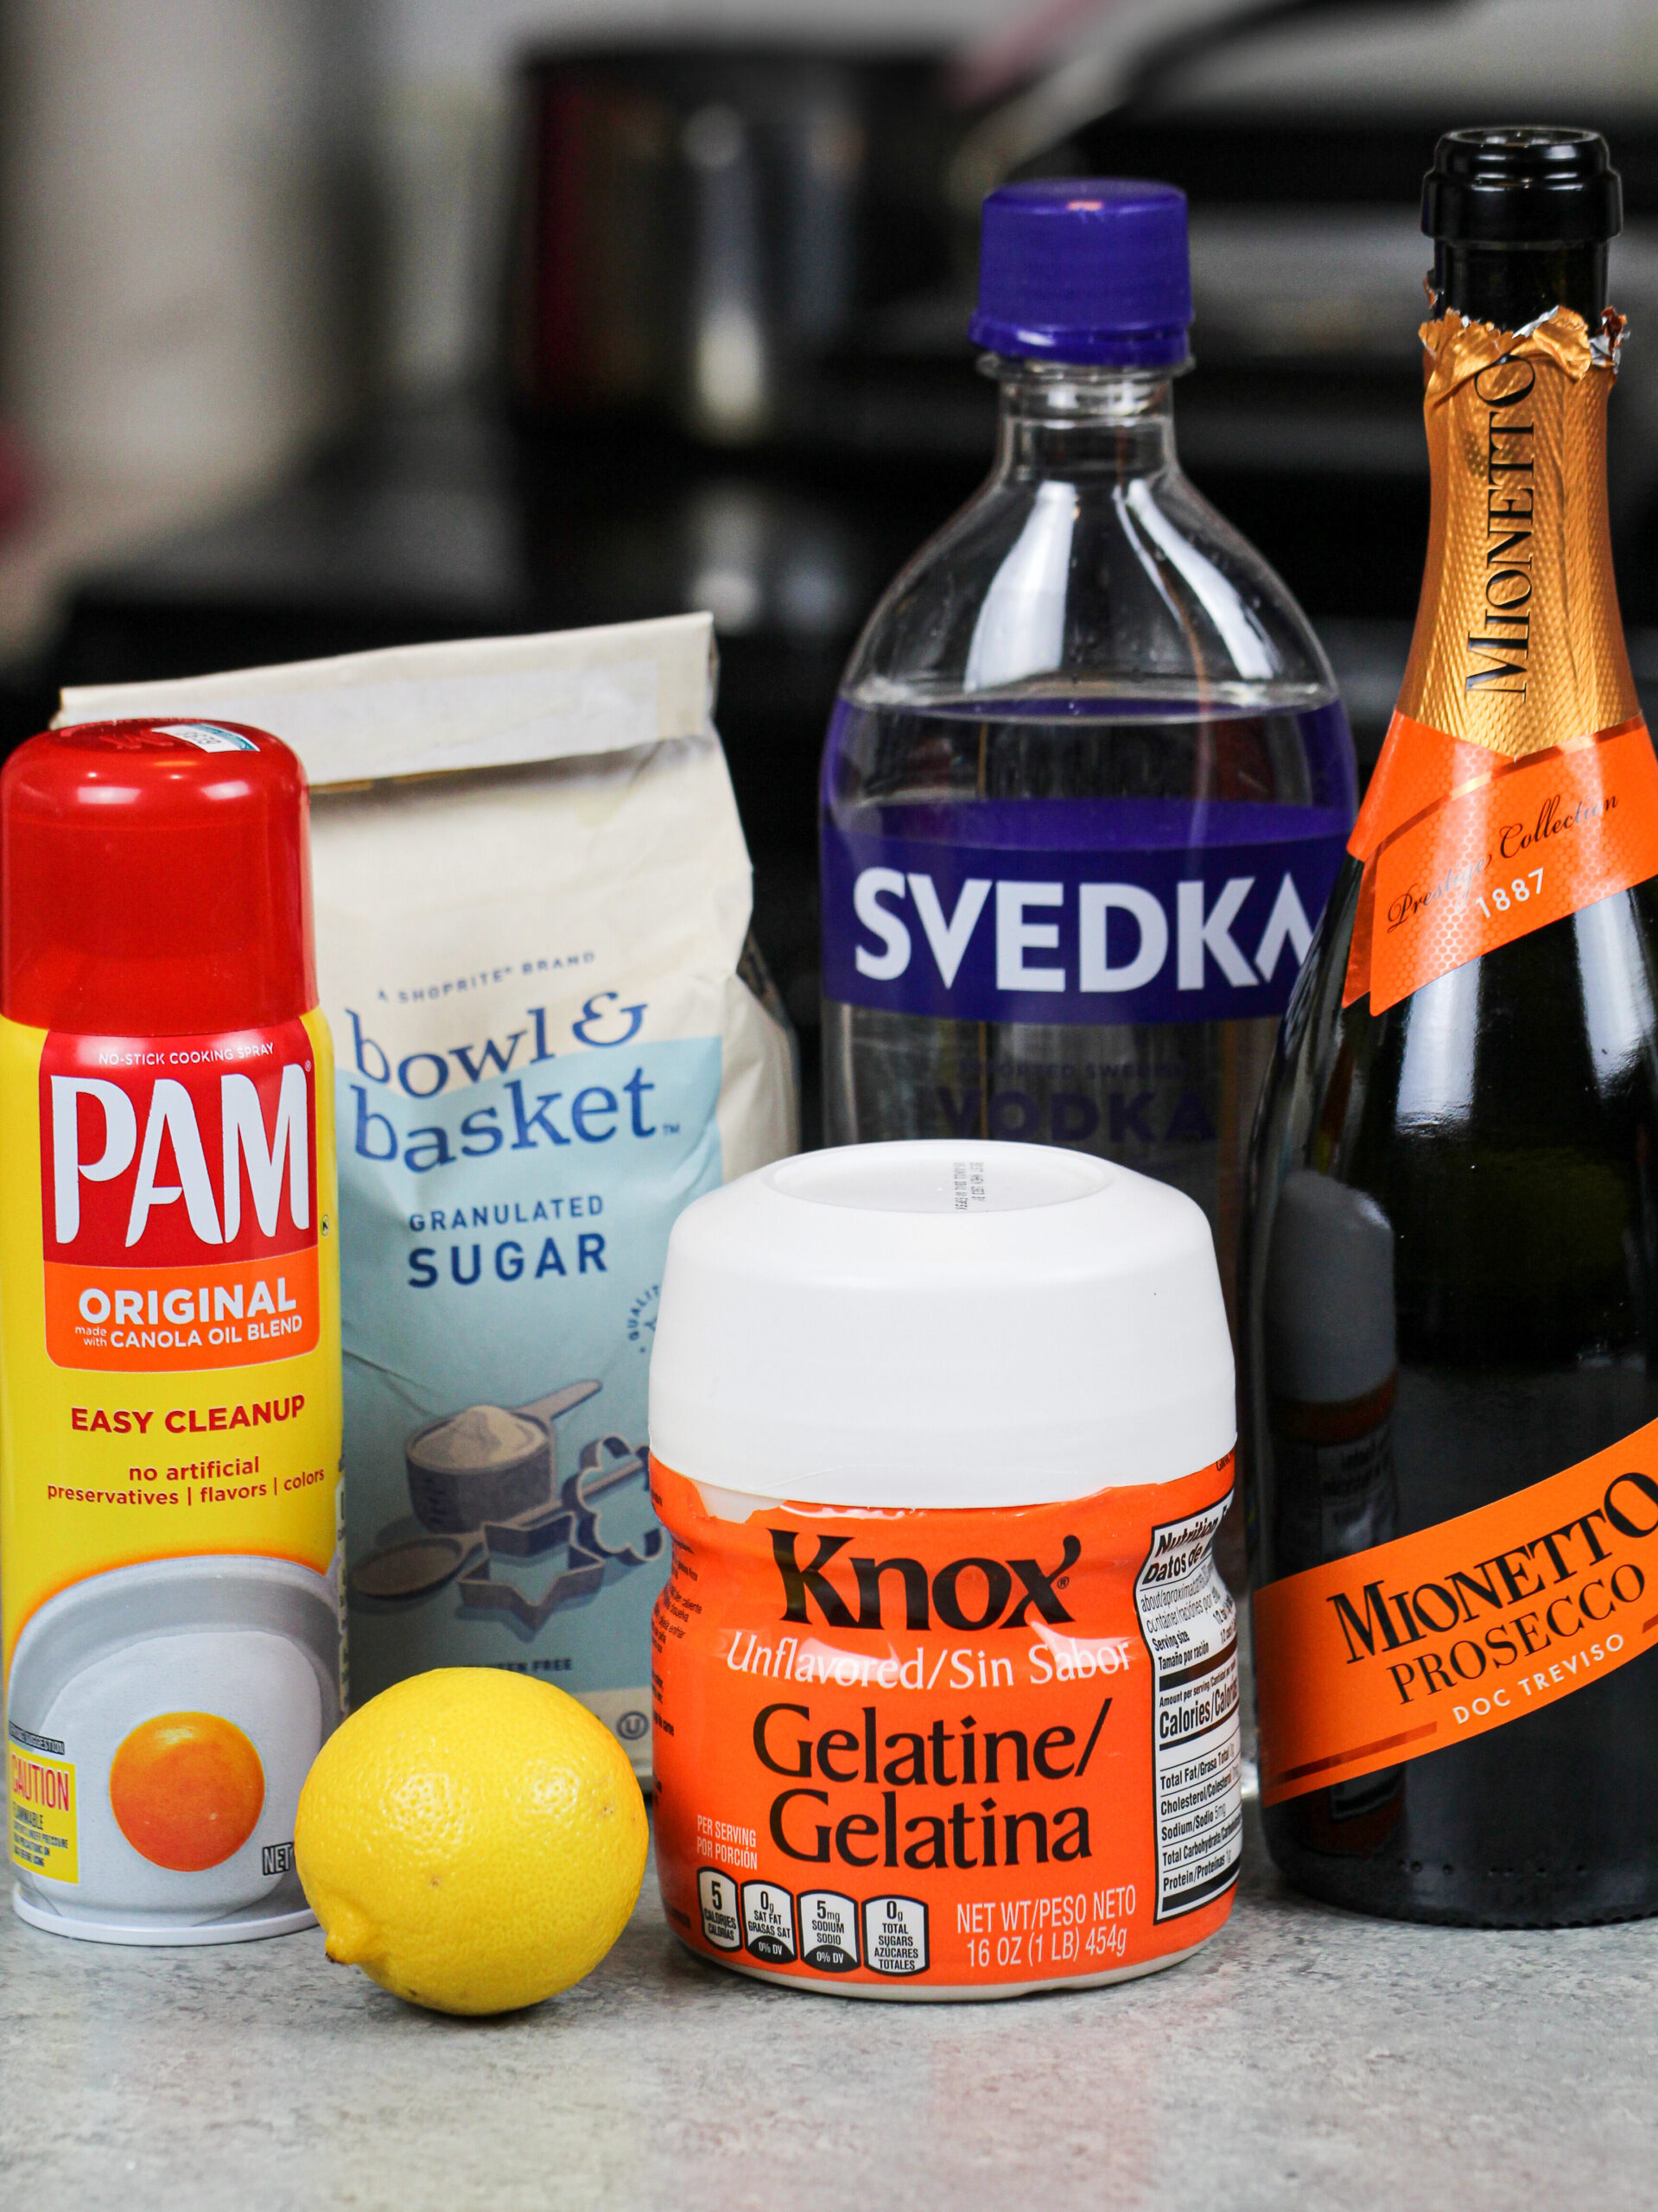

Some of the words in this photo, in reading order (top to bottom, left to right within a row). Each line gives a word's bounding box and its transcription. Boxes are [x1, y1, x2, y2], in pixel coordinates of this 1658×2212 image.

[1465, 355, 1535, 702] MIONETTO
[1499, 794, 1619, 859] Collection
[1475, 867, 1545, 918] 1887
[852, 867, 1318, 993] SVEDKA
[522, 951, 595, 976] BRAND
[98, 1052, 166, 1065] NO-STICK
[169, 1048, 234, 1065] COOKING
[237, 1041, 274, 1059] SPRAY
[345, 1007, 556, 1099] bowl
[571, 992, 648, 1047] &
[349, 1066, 657, 1173] basket
[937, 1090, 1217, 1144] VODKA
[50, 1063, 309, 1248] PAM
[410, 1195, 603, 1232] GRANULATED
[408, 1233, 607, 1289] SUGAR
[79, 1277, 297, 1325] ORIGINAL
[626, 1284, 659, 1342] QUALIT
[74, 1325, 107, 1337] made
[84, 1336, 107, 1347] with
[110, 1330, 202, 1348] CANOLA
[208, 1327, 242, 1345] OIL
[247, 1315, 302, 1341] BLEND
[71, 1407, 154, 1433] EASY
[164, 1395, 305, 1433] CLEANUP
[129, 1466, 158, 1481] no
[166, 1456, 260, 1481] artificial
[48, 1484, 180, 1505] preservatives
[200, 1484, 268, 1503] flavors
[283, 1468, 325, 1492] colors
[1154, 1516, 1219, 1559] Nutrition
[768, 1528, 1083, 1631] Knox
[1142, 1553, 1186, 1586] Datos
[1188, 1542, 1204, 1567] de
[1326, 1472, 1658, 1664] MIONETTO
[1152, 1635, 1179, 1651] Serving
[1177, 1630, 1190, 1644] size
[1387, 1564, 1645, 1705] PROSECCO
[532, 1658, 572, 1672] FREE
[1029, 1637, 1134, 1685] Sabor
[1158, 1650, 1183, 1671] Tamaño
[1184, 1651, 1193, 1668] por
[1452, 1688, 1511, 1725] DOC
[1518, 1634, 1624, 1696] TREVISO
[1159, 1692, 1182, 1708] Amount
[1183, 1689, 1193, 1702] per
[12, 1754, 69, 1811] CAUTION
[1160, 1770, 1183, 1790] Total
[697, 1815, 714, 1836] PER
[715, 1821, 757, 1847] SERVING
[769, 1788, 1092, 1869] Gelatina
[262, 1842, 292, 1876] NET
[697, 1836, 714, 1858] POR
[715, 1844, 758, 1870] PORCIÓN
[1162, 1847, 1182, 1866] Total
[711, 1880, 722, 1910] 5
[760, 1891, 774, 1913] 0g
[816, 1900, 841, 1923] 5mg
[886, 1900, 904, 1922] 0g
[957, 1903, 996, 1934] NET
[1001, 1893, 1087, 1932] WT/PESO
[1093, 1884, 1136, 1922] NETO
[704, 1908, 737, 1929] CALORIES
[747, 1921, 776, 1937] GRASAS
[777, 1926, 791, 1939] SAT
[753, 1910, 768, 1923] SAT
[769, 1913, 782, 1925] FAT
[811, 1920, 845, 1935] SODIUM
[882, 1923, 909, 1935] TOTAL
[759, 1942, 772, 1954] 0%
[772, 1943, 783, 1955] DV
[816, 1933, 842, 1946] SODIO
[873, 1944, 919, 1958] AZÚCARES
[878, 1936, 914, 1947] SUGARS
[967, 1938, 990, 1967] 16
[997, 1936, 1022, 1966] OZ
[1028, 1931, 1044, 1967] (1
[1051, 1926, 1080, 1963] LB)
[1085, 1923, 1128, 1958] 454g
[816, 1951, 830, 1962] 0%
[832, 1953, 844, 1964] DV
[879, 1959, 916, 1971] TOTALES
